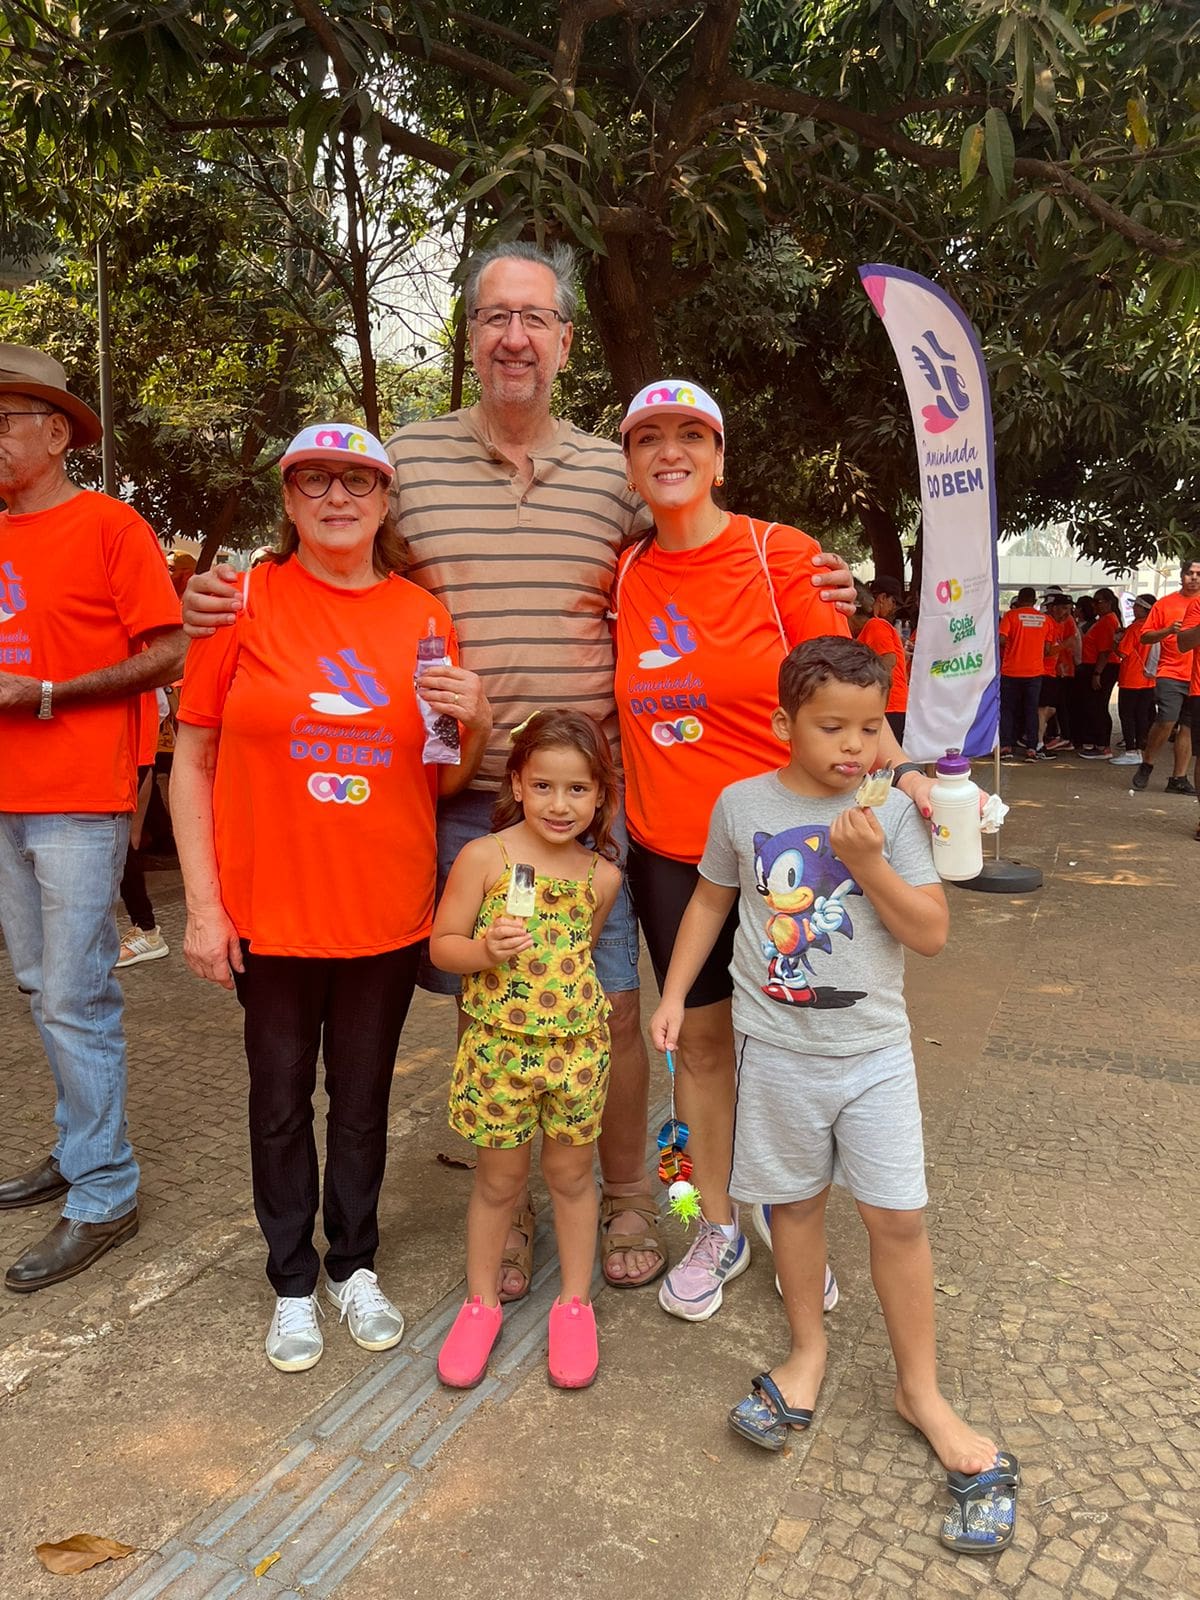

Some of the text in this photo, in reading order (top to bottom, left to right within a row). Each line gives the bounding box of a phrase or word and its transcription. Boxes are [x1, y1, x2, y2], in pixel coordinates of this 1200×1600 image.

[645, 387, 697, 407] OVG
[314, 430, 368, 454] OVG
[942, 467, 984, 497] BEM
[941, 652, 984, 674] GOIÁS
[628, 671, 704, 694] Caminhada
[630, 693, 708, 716] DO BEM
[290, 712, 395, 745] Caminhada
[652, 715, 703, 746] OVG
[290, 739, 393, 768] DO BEM
[309, 773, 369, 804] OVG
